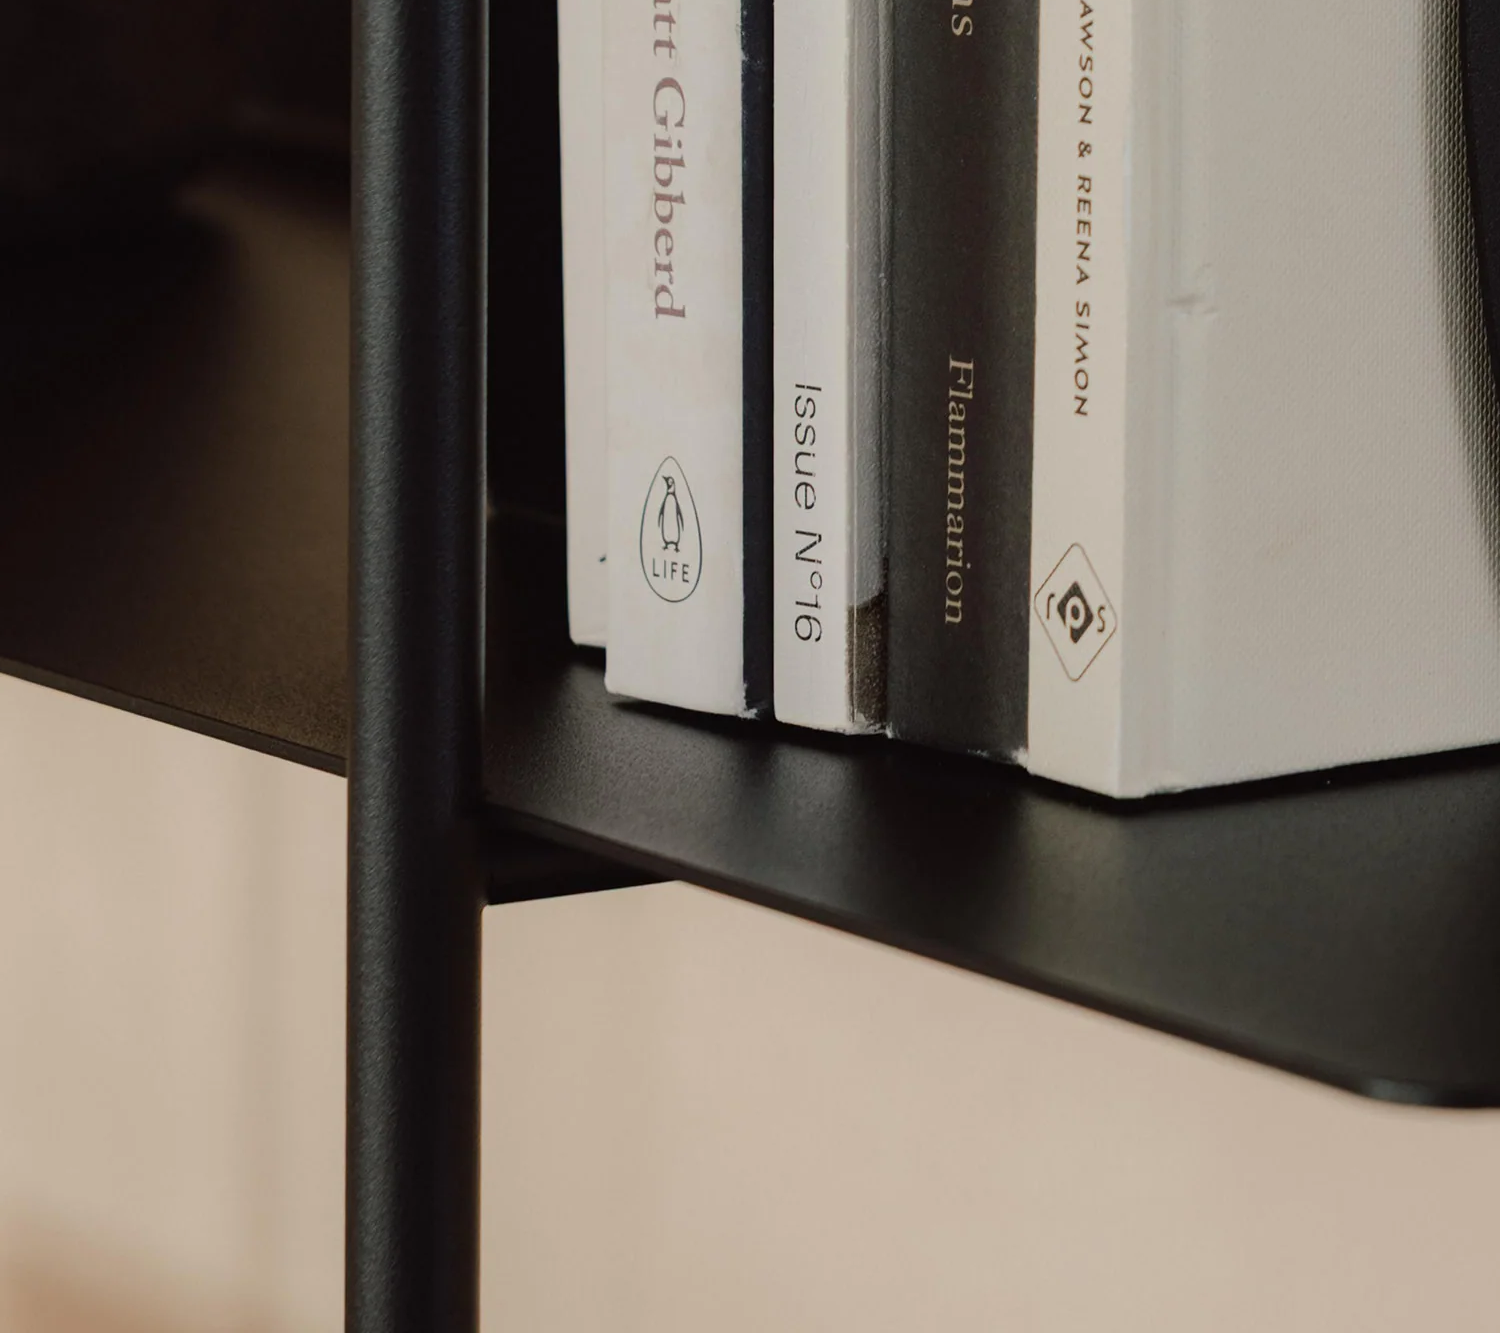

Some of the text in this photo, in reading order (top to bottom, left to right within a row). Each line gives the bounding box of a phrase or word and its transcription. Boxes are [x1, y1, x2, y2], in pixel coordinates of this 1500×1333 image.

[652, 76, 687, 320] Gibberd
[1077, 140, 1093, 158] &
[1076, 174, 1092, 285] REENA
[1073, 300, 1091, 417] SIMON
[794, 383, 822, 511] Issue
[944, 354, 974, 624] Flammarion
[652, 558, 690, 584] LIFE
